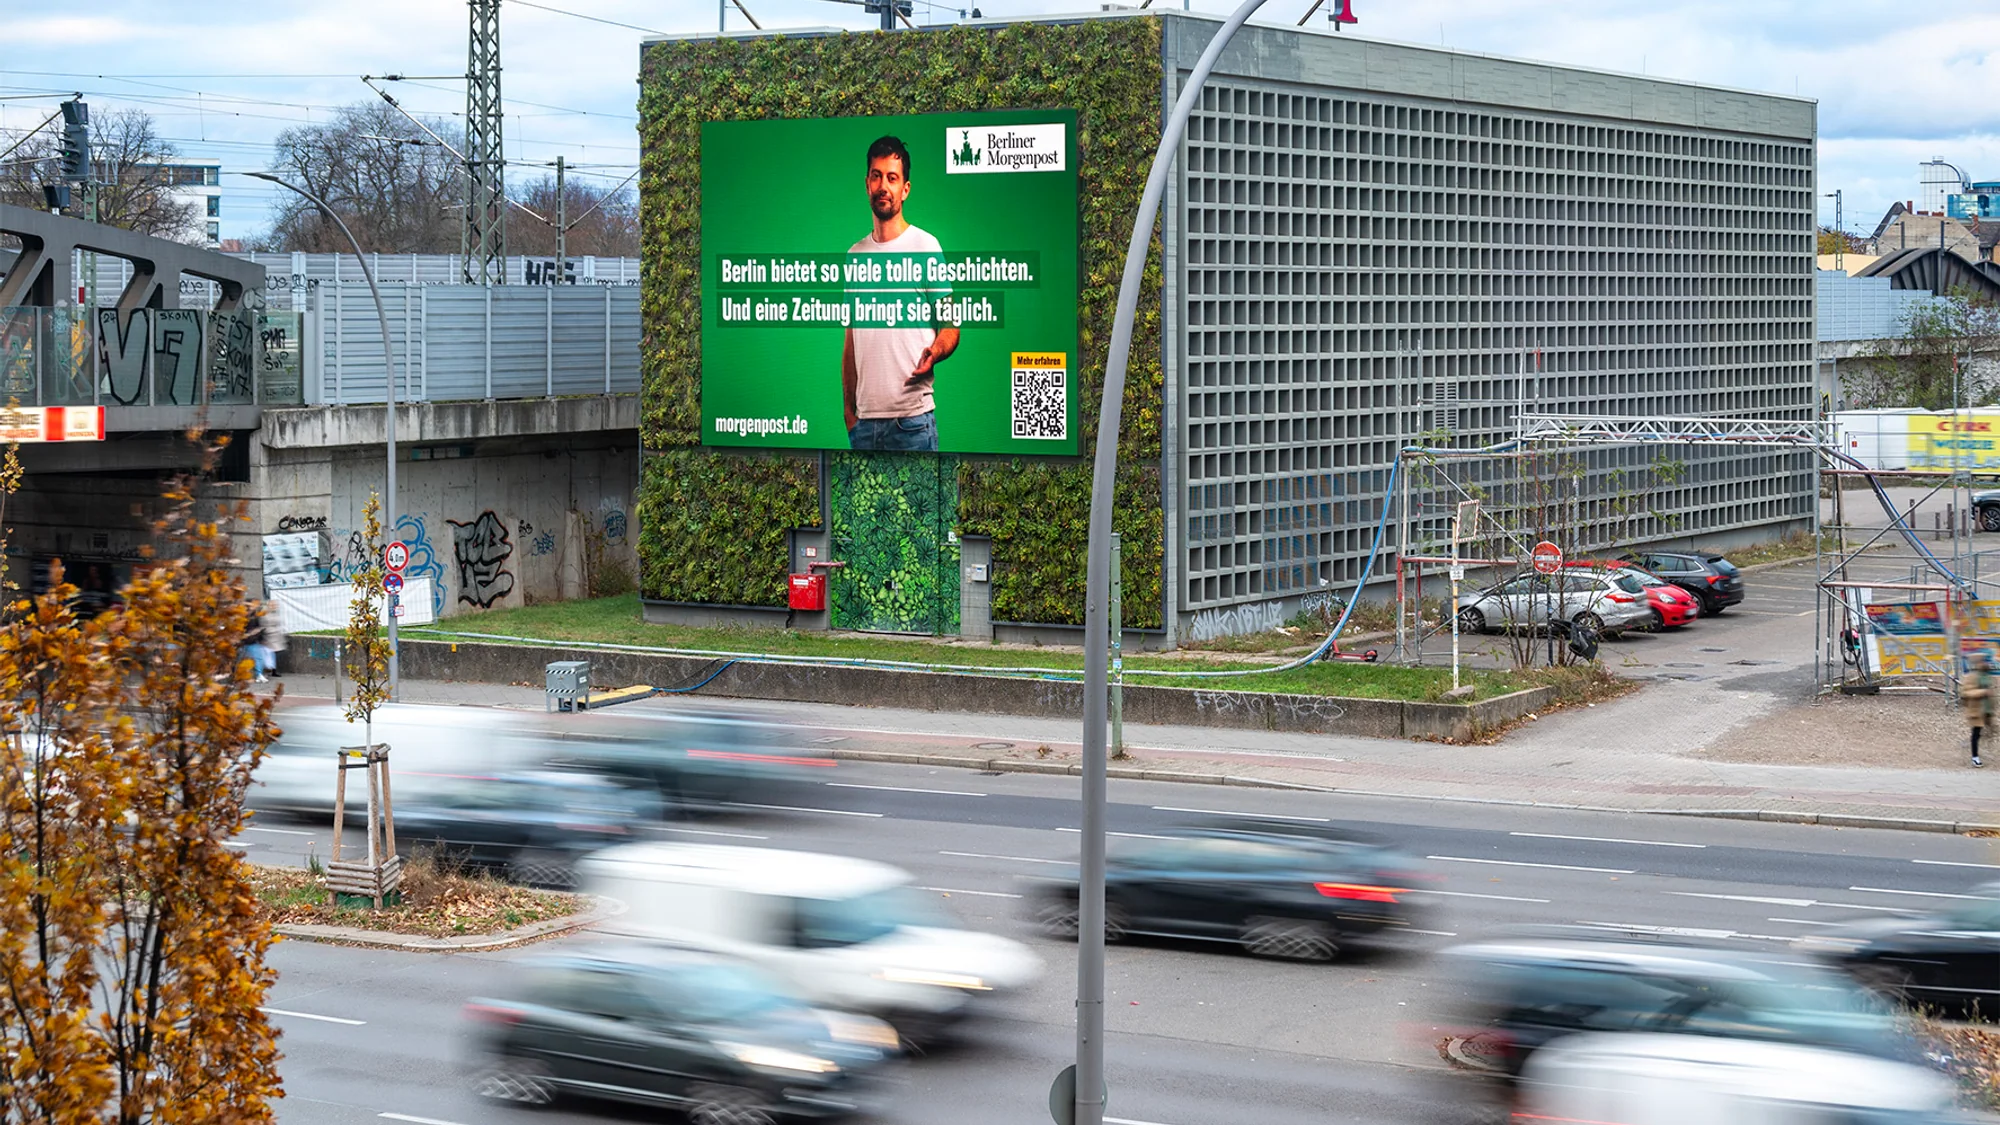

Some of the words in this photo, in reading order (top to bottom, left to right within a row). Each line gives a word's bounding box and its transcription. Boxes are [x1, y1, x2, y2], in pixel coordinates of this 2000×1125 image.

[987, 132, 1036, 149] Berliner
[987, 150, 1058, 170] Morgenpost
[721, 259, 767, 283] Berlin
[770, 259, 817, 283] bietet
[820, 263, 840, 283] so
[843, 257, 882, 283] viele
[885, 257, 922, 282] tolle
[926, 256, 1034, 282] Geschichten.
[721, 297, 751, 321] Und
[755, 297, 788, 322] eine
[791, 297, 851, 327] Zeitung
[854, 297, 904, 327] bringt
[906, 297, 932, 322] sie
[934, 296, 998, 327] täglich.
[1017, 356, 1033, 365] Mehr
[1034, 356, 1061, 366] erfahren
[715, 414, 808, 437] morgenpost.de
